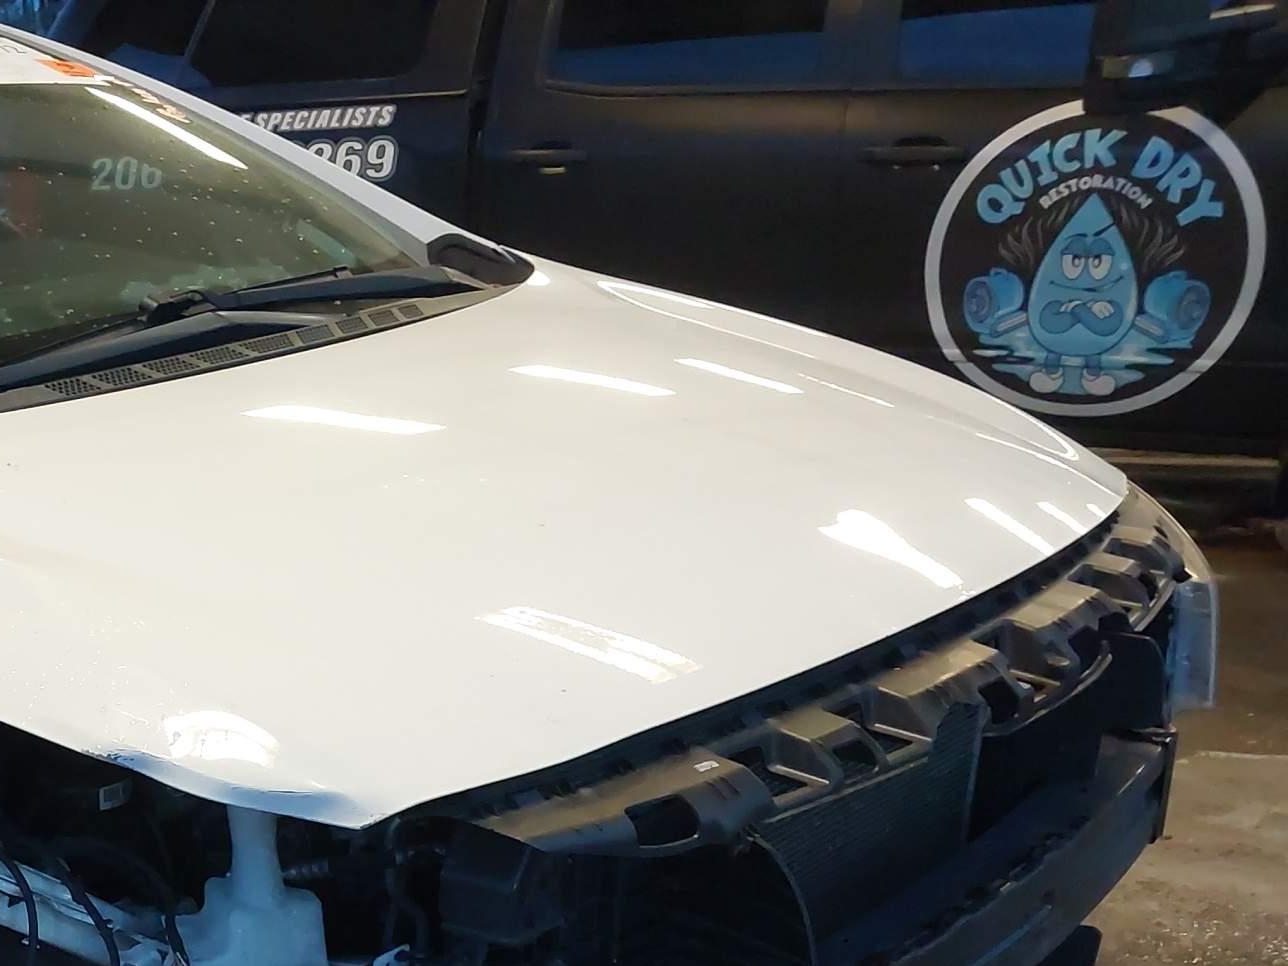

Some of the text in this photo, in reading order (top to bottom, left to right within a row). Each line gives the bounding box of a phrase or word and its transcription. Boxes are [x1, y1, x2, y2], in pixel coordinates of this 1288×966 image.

[255, 105, 396, 132] SPECIALISTS
[976, 128, 1225, 227] QUICK DRY
[1039, 174, 1152, 209] RESTORATION
